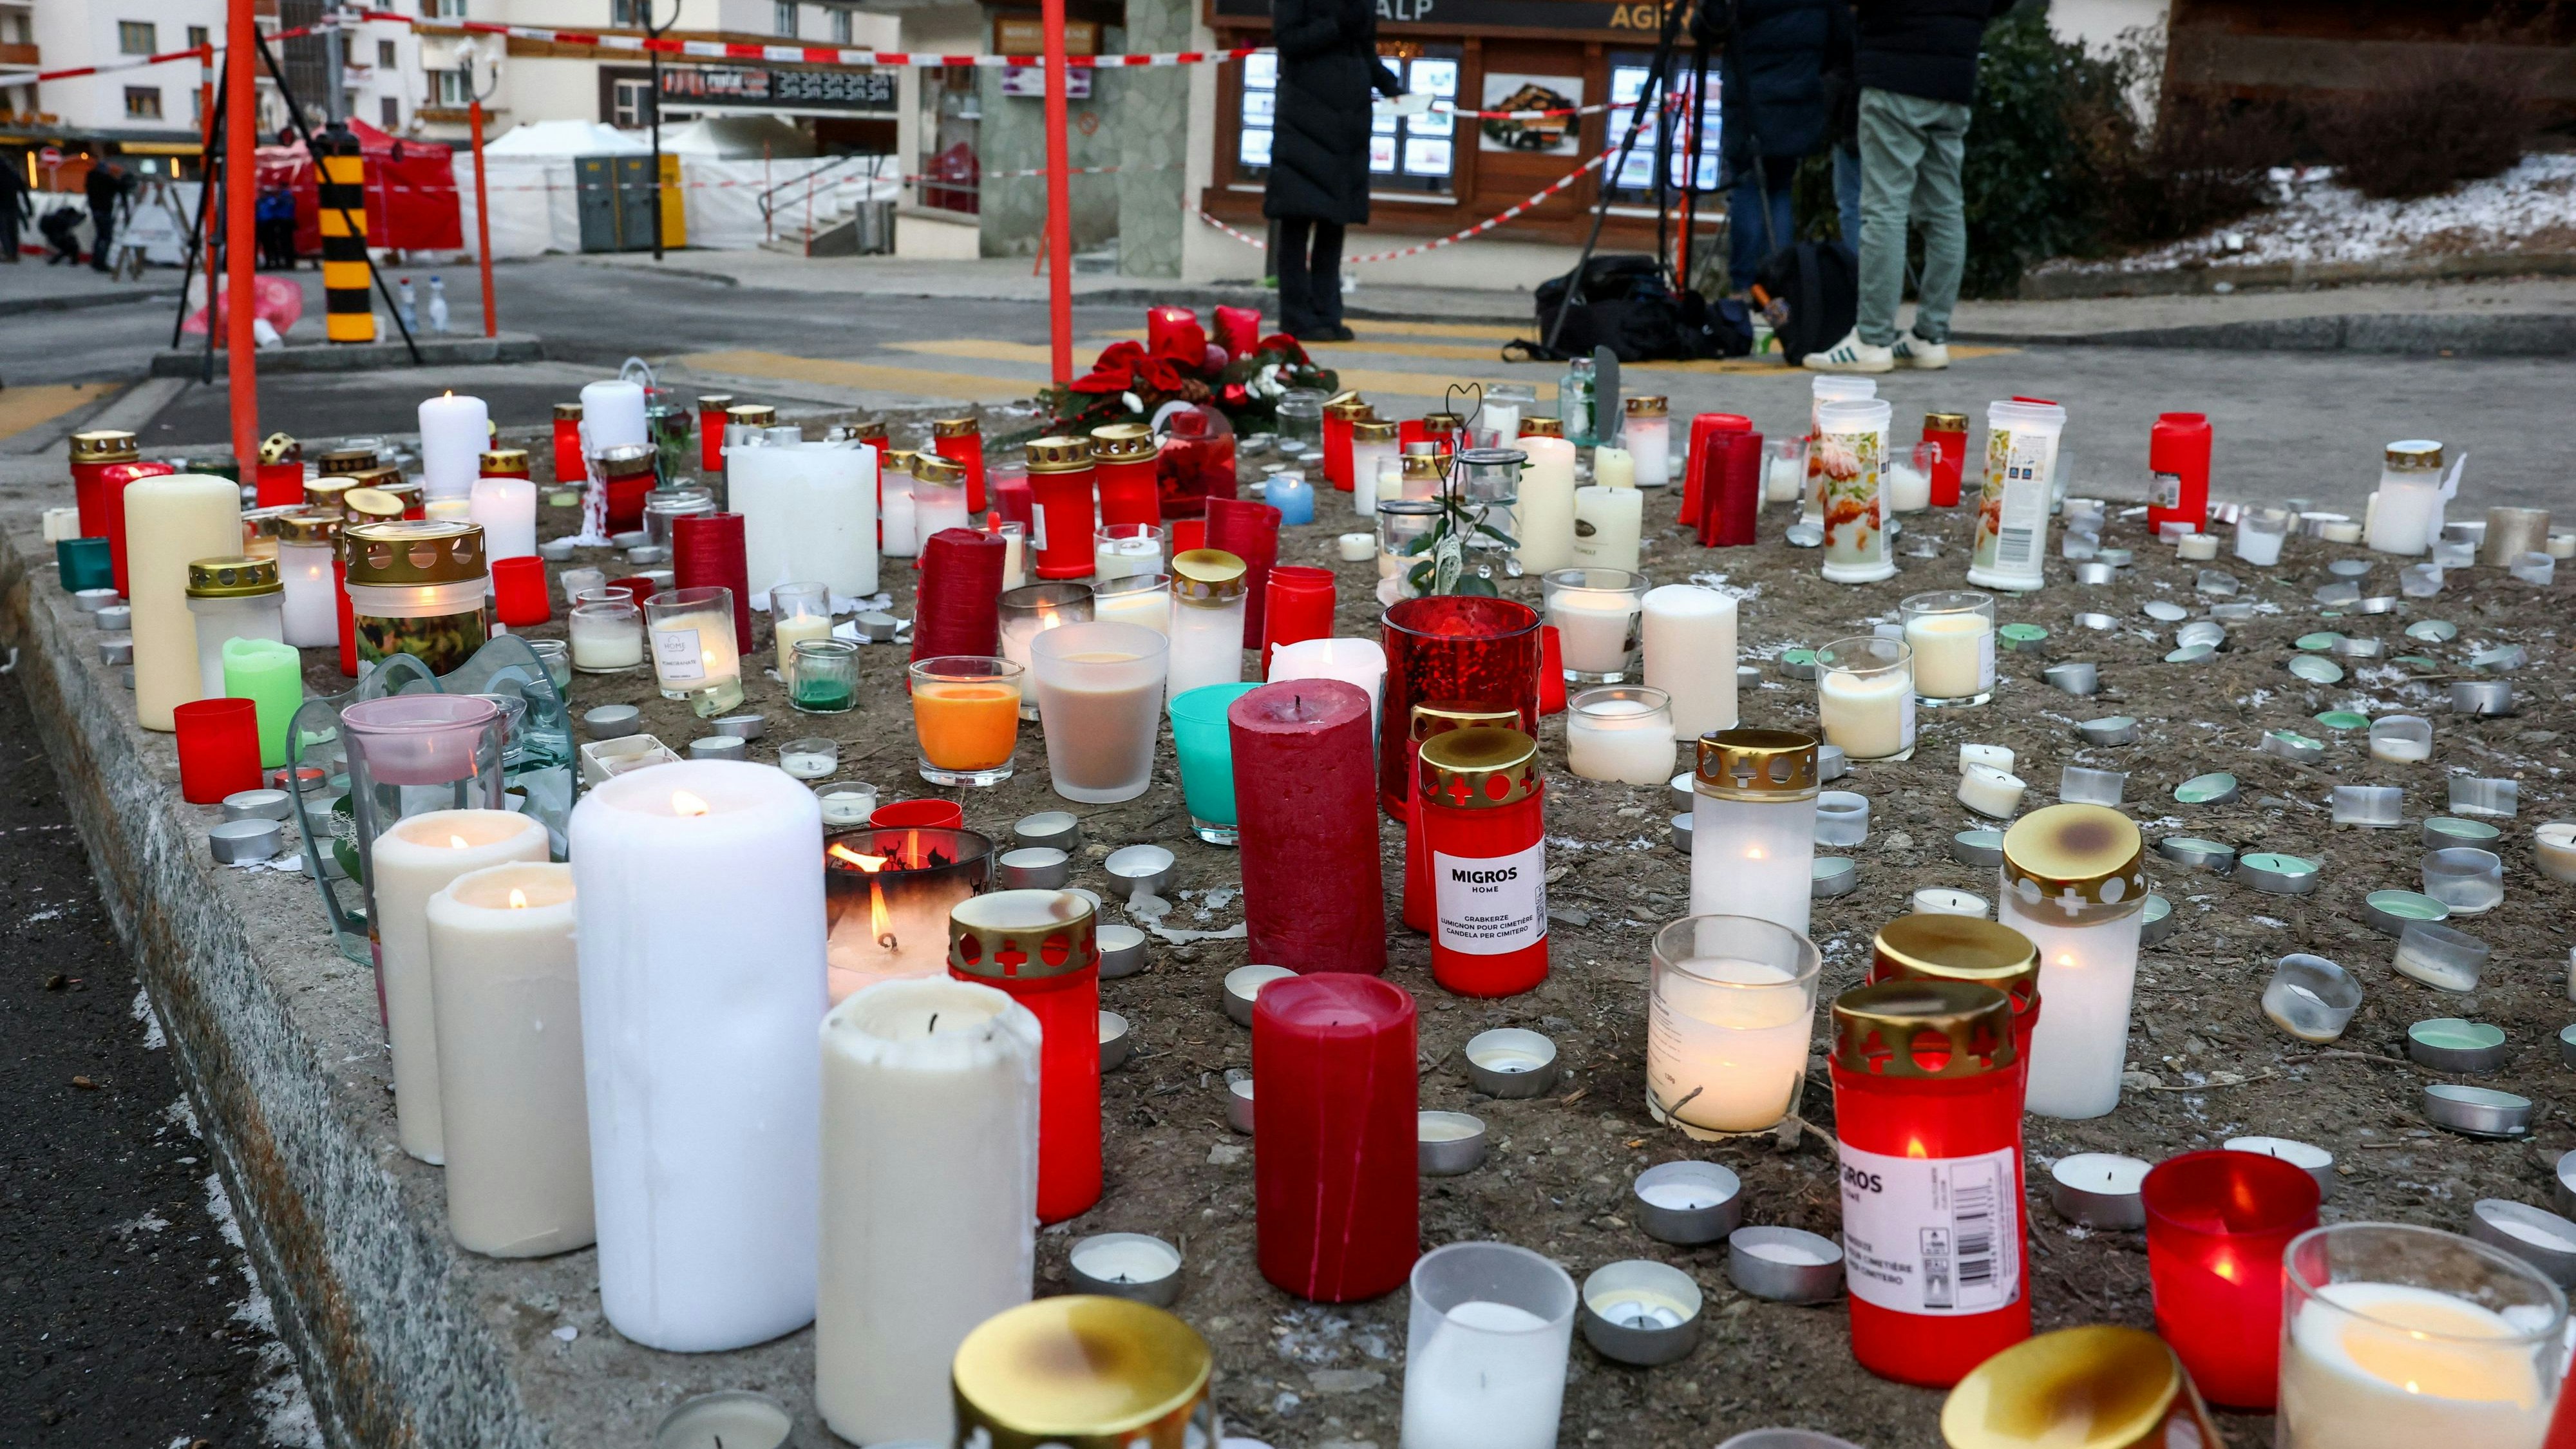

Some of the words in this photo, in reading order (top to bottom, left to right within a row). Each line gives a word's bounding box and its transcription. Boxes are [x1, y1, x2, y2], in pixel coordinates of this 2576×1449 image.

[1452, 867, 1517, 883] MIGROS
[1441, 917, 1475, 930] LUMIGNON
[1499, 914, 1533, 929] CIMETIÈRE
[1446, 927, 1478, 938] CANDELA
[1496, 925, 1528, 938] CIMITERO
